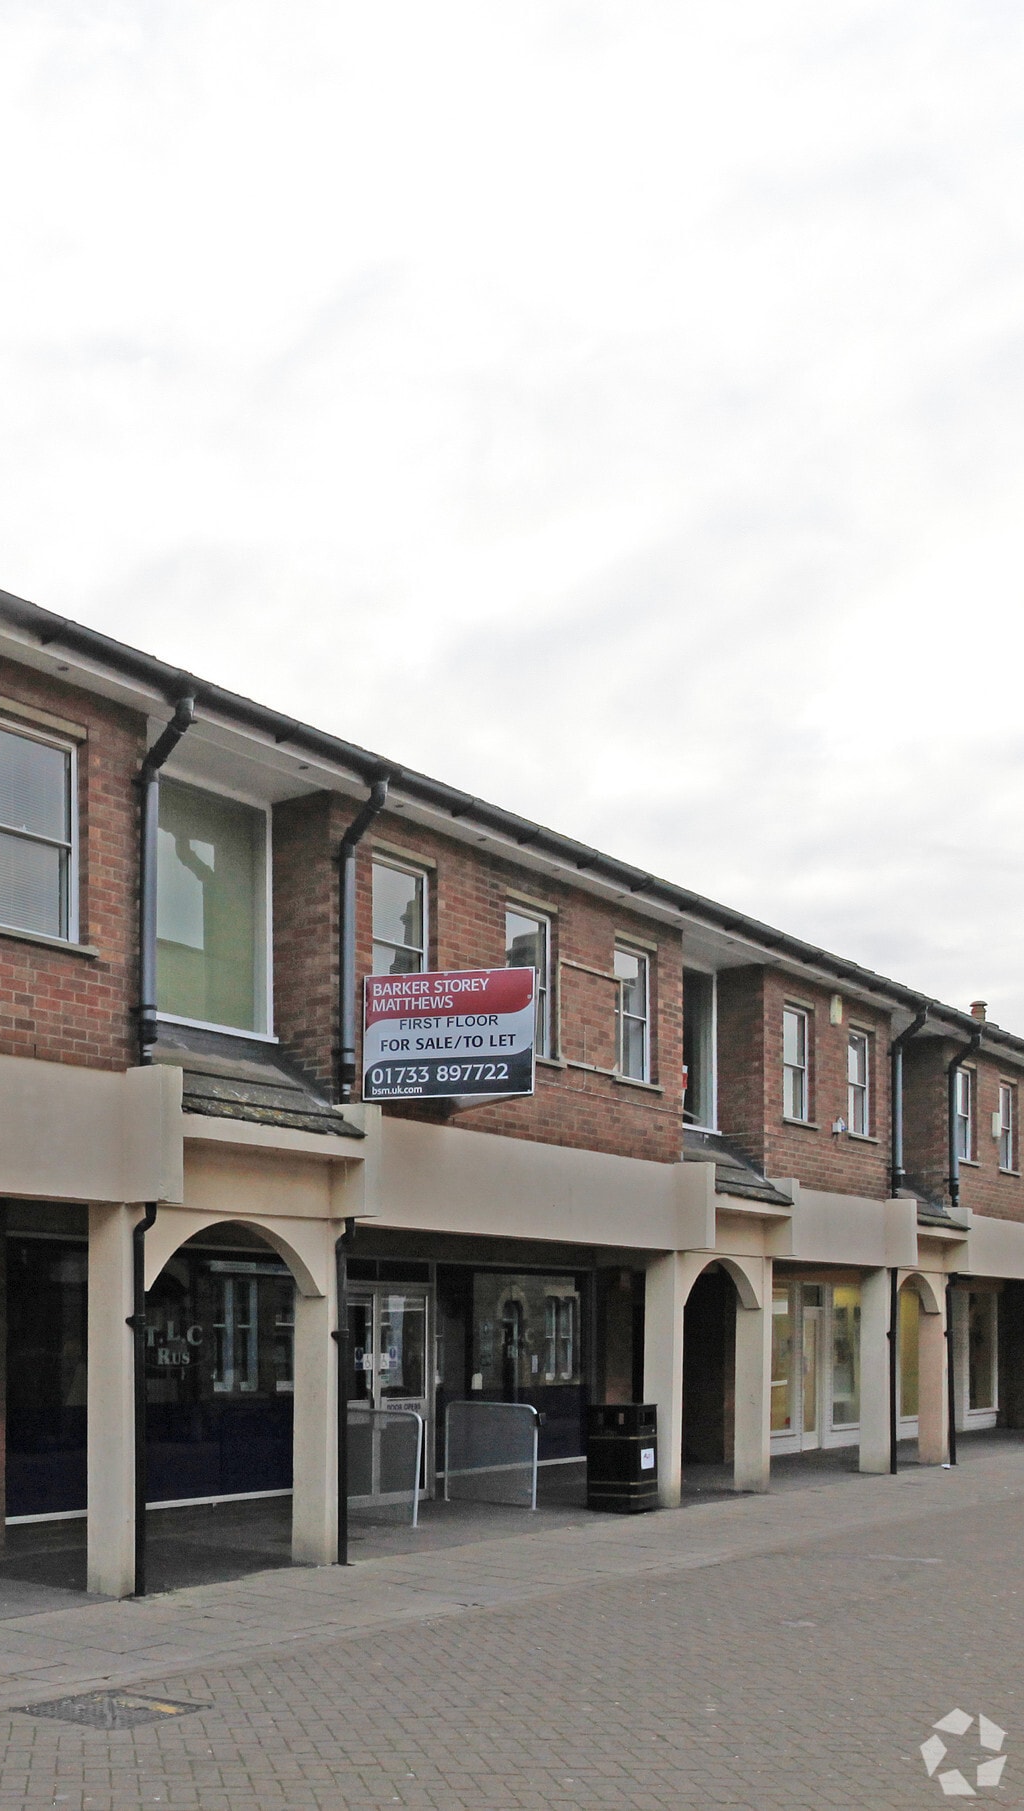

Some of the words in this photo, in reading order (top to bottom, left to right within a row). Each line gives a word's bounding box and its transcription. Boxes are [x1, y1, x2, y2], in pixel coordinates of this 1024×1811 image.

[373, 981, 430, 996] BARKER
[434, 978, 490, 993] STOREY
[372, 996, 454, 1012] MATTHEWS
[399, 1018, 441, 1030] FIRST
[446, 1015, 499, 1028] FLOOR
[380, 1038, 410, 1052] FOR
[416, 1036, 483, 1050] SALE/TO
[489, 1034, 517, 1047] LET
[371, 1066, 429, 1084] 01733
[436, 1063, 509, 1082] 897722
[371, 1086, 423, 1096] bsm.uk.com
